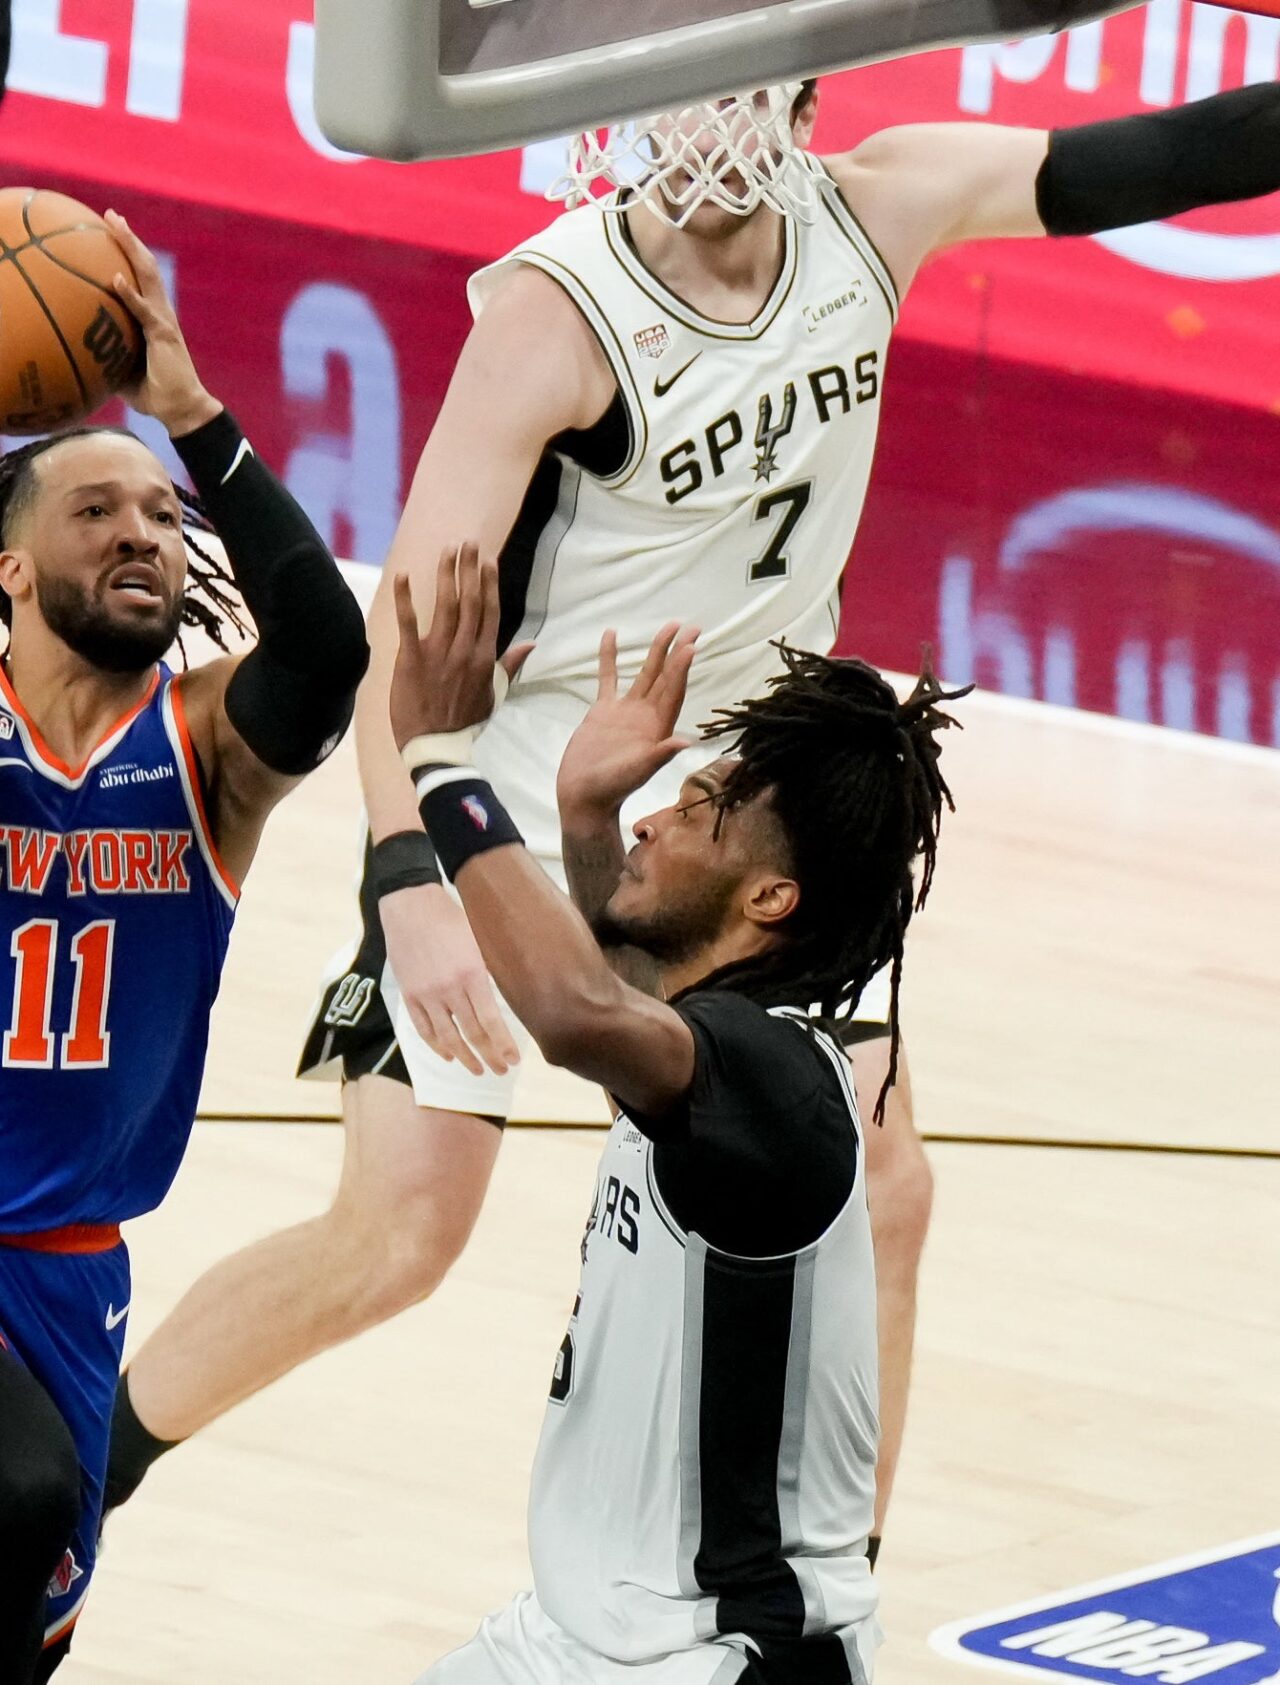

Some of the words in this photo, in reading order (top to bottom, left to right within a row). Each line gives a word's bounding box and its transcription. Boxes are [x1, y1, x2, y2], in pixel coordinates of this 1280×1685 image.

[811, 291, 857, 322] LEDGER
[659, 350, 878, 505] SPURS
[745, 475, 817, 587] 7
[100, 769, 129, 788] abu
[131, 762, 174, 783] dhabi
[62, 828, 192, 898] YORK
[2, 918, 116, 1070] 11
[999, 1610, 1267, 1685] NBA
